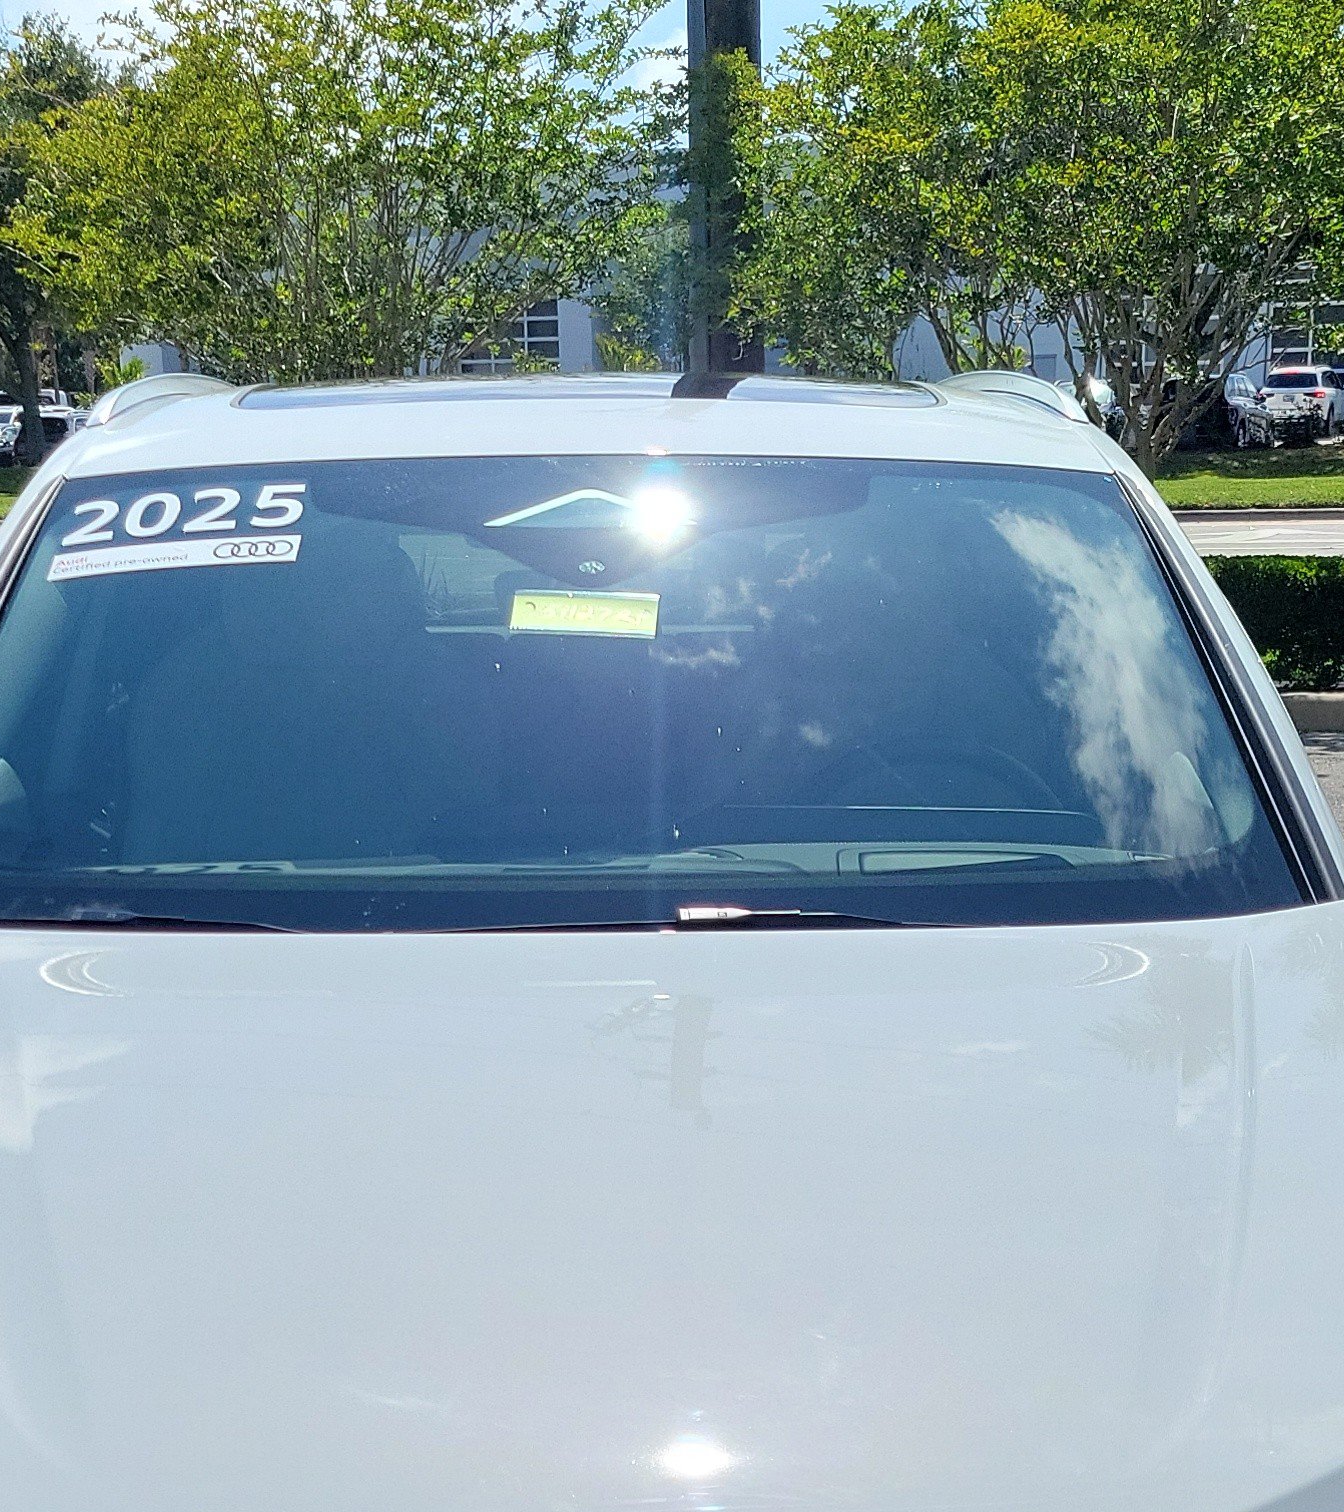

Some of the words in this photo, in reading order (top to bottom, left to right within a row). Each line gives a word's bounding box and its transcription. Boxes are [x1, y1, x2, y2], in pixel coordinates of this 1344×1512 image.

[61, 483, 306, 547] 2025
[54, 556, 88, 568] Audi
[114, 554, 188, 568] pre-owned
